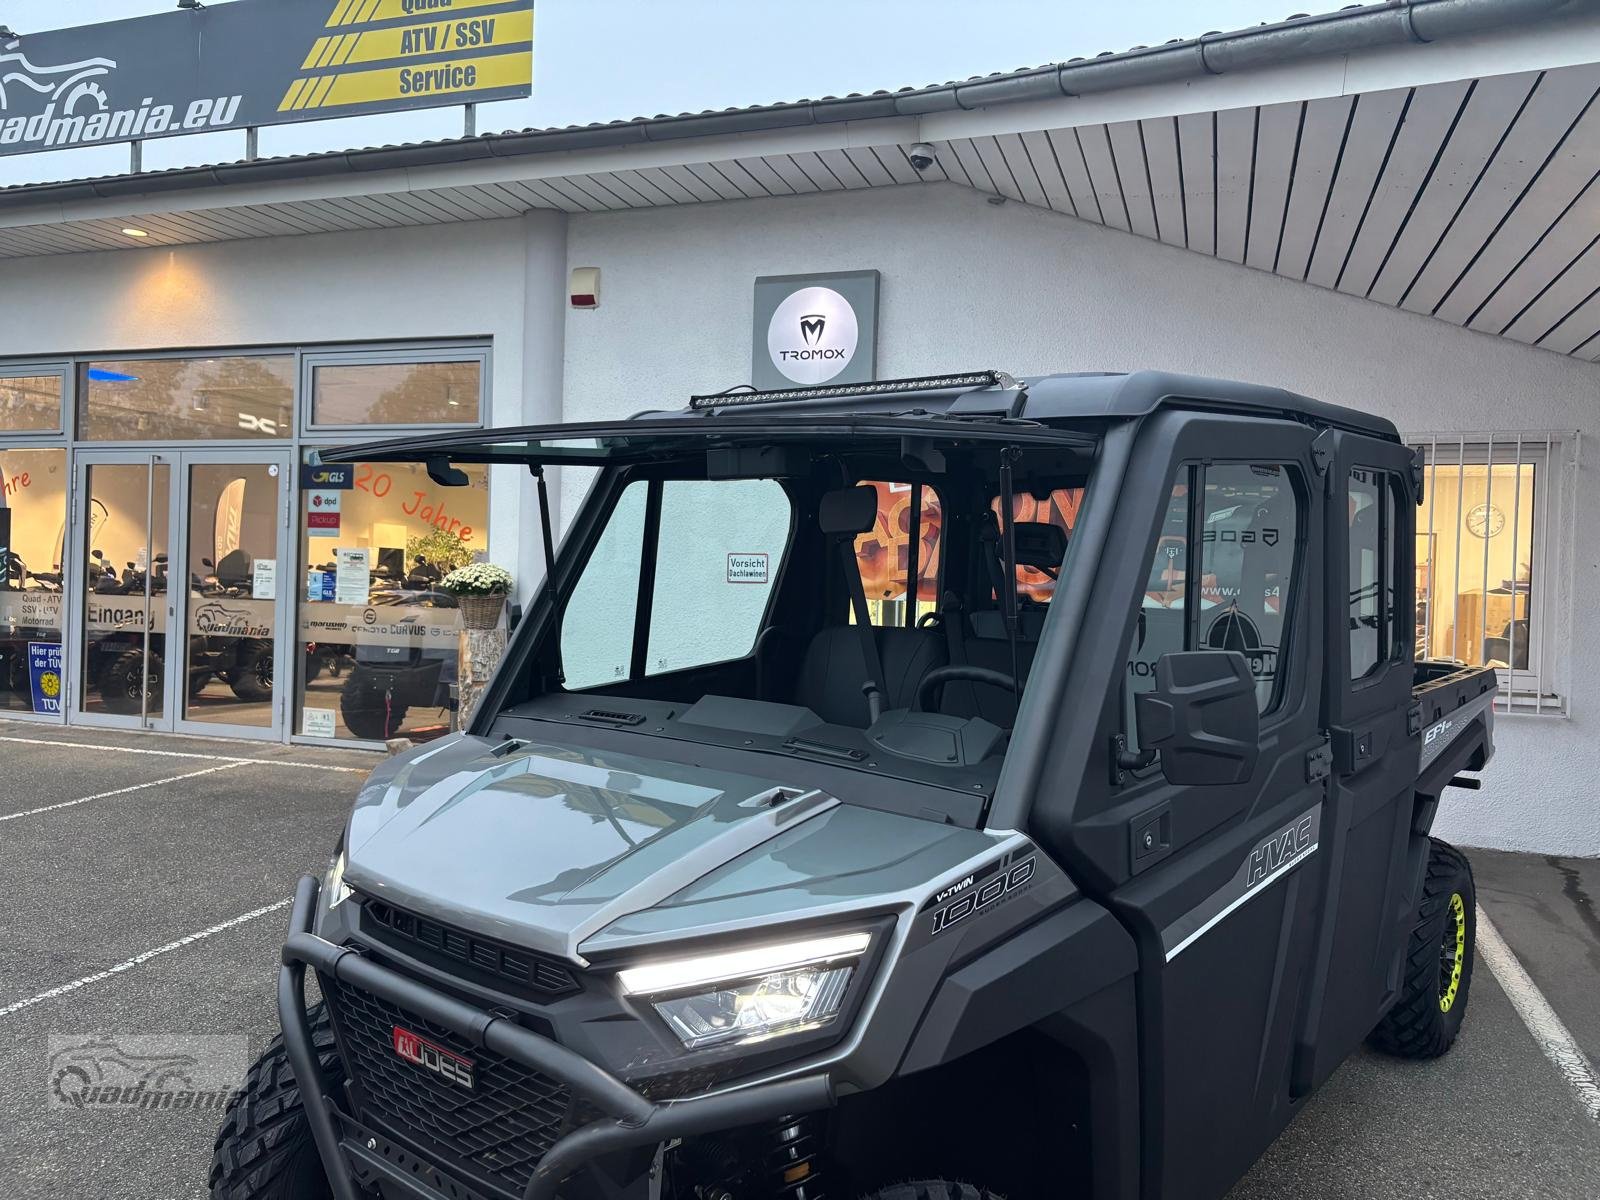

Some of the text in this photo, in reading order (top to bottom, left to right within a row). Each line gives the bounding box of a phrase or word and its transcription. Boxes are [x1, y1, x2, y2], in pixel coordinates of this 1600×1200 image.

[400, 26, 437, 54] ATV
[455, 19, 495, 47] SSV
[400, 64, 476, 94] Service
[0, 95, 243, 146] admania.eu
[780, 349, 845, 361] TROMOX
[329, 472, 344, 483] GLS
[324, 497, 336, 506] dpd
[355, 463, 473, 542] 20 Jahre
[731, 558, 765, 568] Vorsicht
[22, 594, 42, 603] Quad
[47, 595, 62, 603] ATV
[22, 605, 37, 613] SSV
[22, 616, 54, 626] Motorrad
[88, 603, 155, 630] Eingang
[196, 613, 271, 637] Quadmania
[31, 646, 47, 656] Hier
[34, 658, 46, 667] der
[1424, 720, 1447, 745] EFI
[1246, 815, 1312, 888] HVAC
[931, 855, 1037, 935] 1000
[936, 875, 975, 903] V-TWIN
